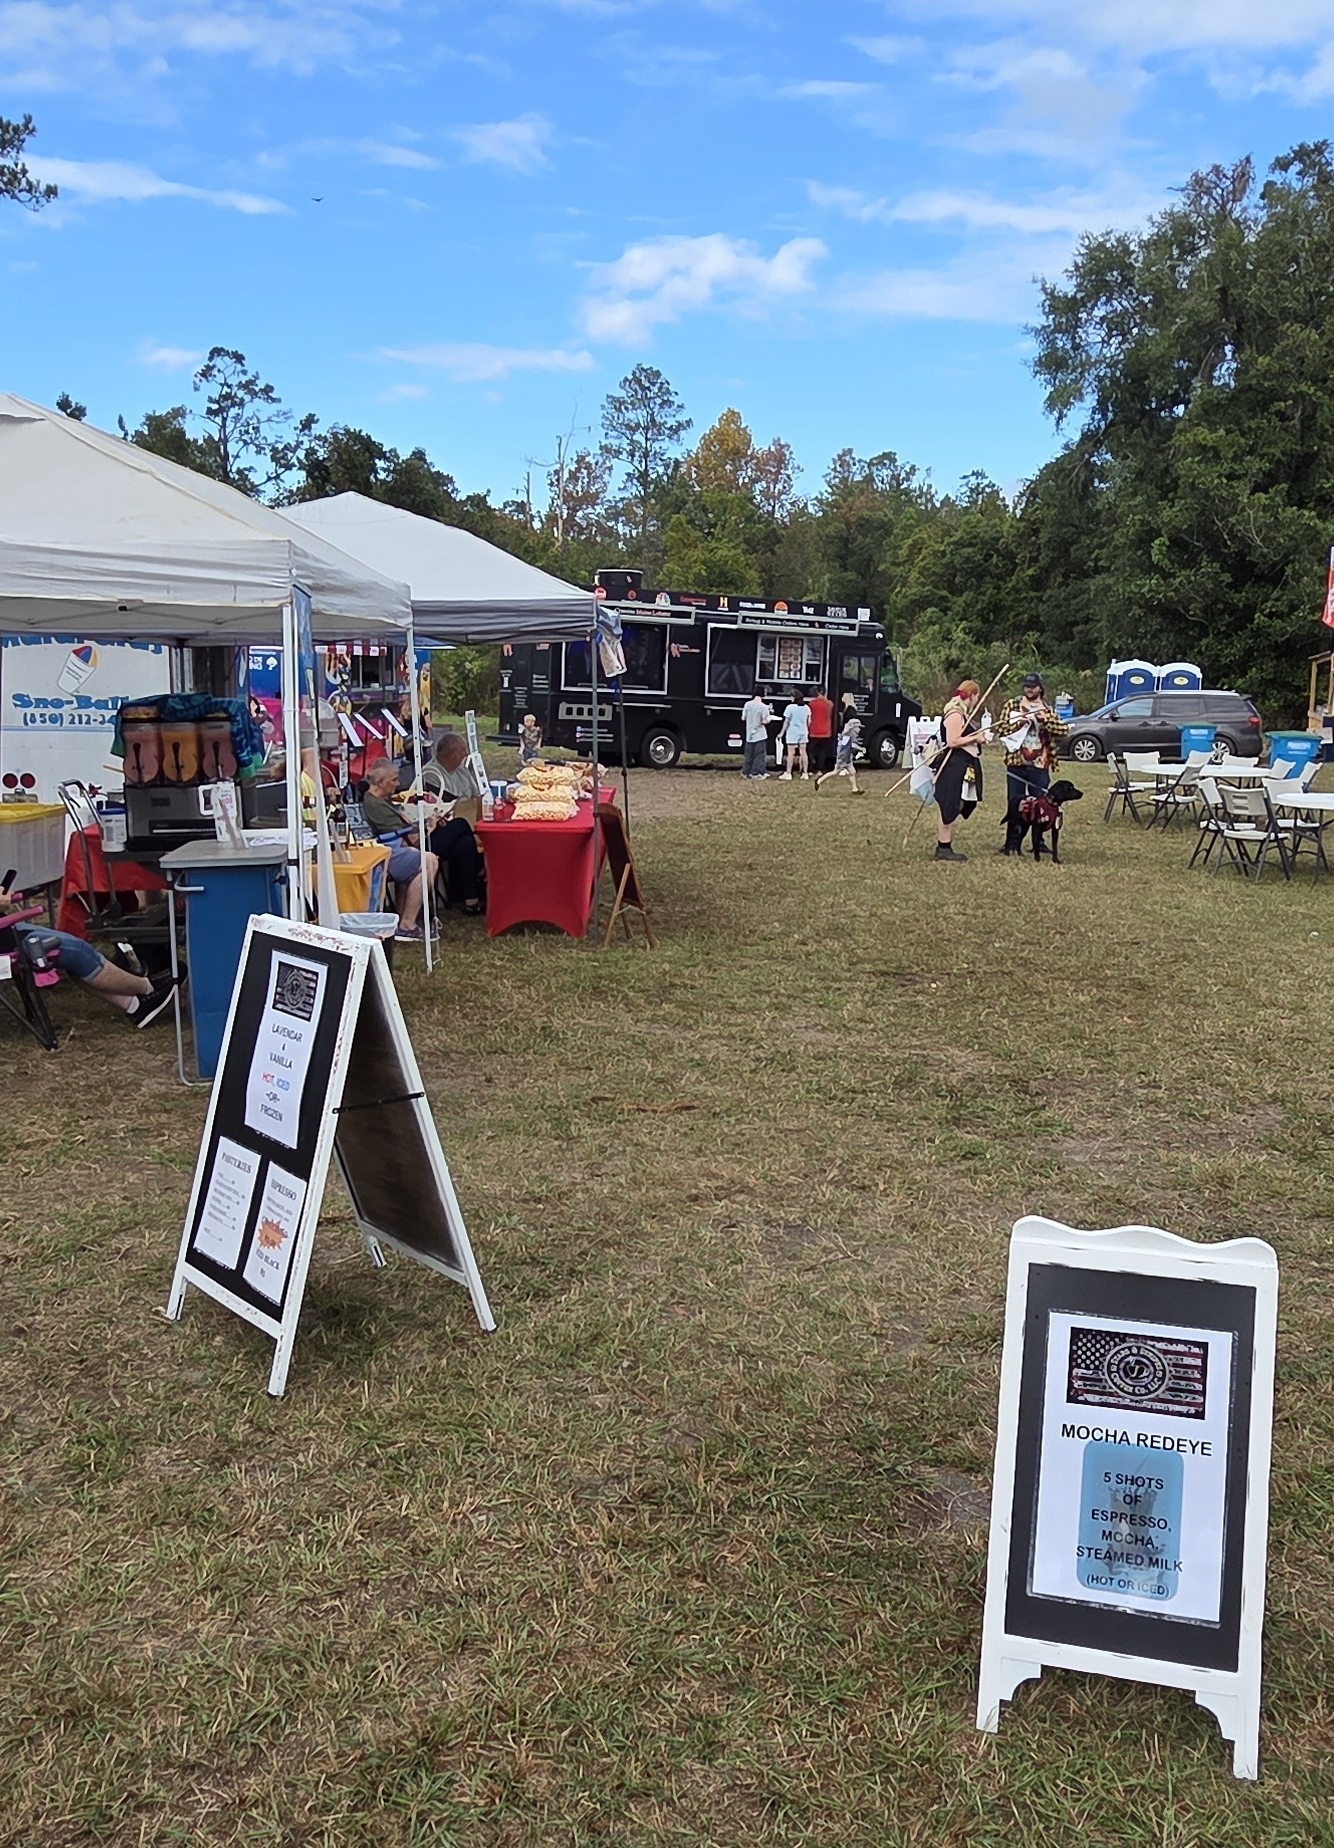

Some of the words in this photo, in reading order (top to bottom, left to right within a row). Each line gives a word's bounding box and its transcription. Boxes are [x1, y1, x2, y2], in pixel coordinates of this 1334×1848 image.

[23, 711, 64, 728] (850)
[269, 1052, 293, 1069] VANILLA
[276, 1077, 290, 1091] ICED
[259, 1103, 283, 1122] FROZEN
[1148, 1378, 1162, 1391] LLC
[1061, 1423, 1131, 1446] MOCHA
[1136, 1433, 1212, 1456] REDEYE
[1103, 1472, 1111, 1483] 5
[1115, 1473, 1164, 1490] SHOTS
[1123, 1494, 1142, 1506] OF
[1091, 1508, 1171, 1533] ESPRESSO,
[1101, 1529, 1159, 1549] MOCHA,
[1076, 1545, 1144, 1566] STEAMED
[1148, 1556, 1183, 1572] MILK
[1087, 1574, 1115, 1586] (HOT
[1117, 1578, 1135, 1590] OR
[1137, 1583, 1170, 1596] ICED)
